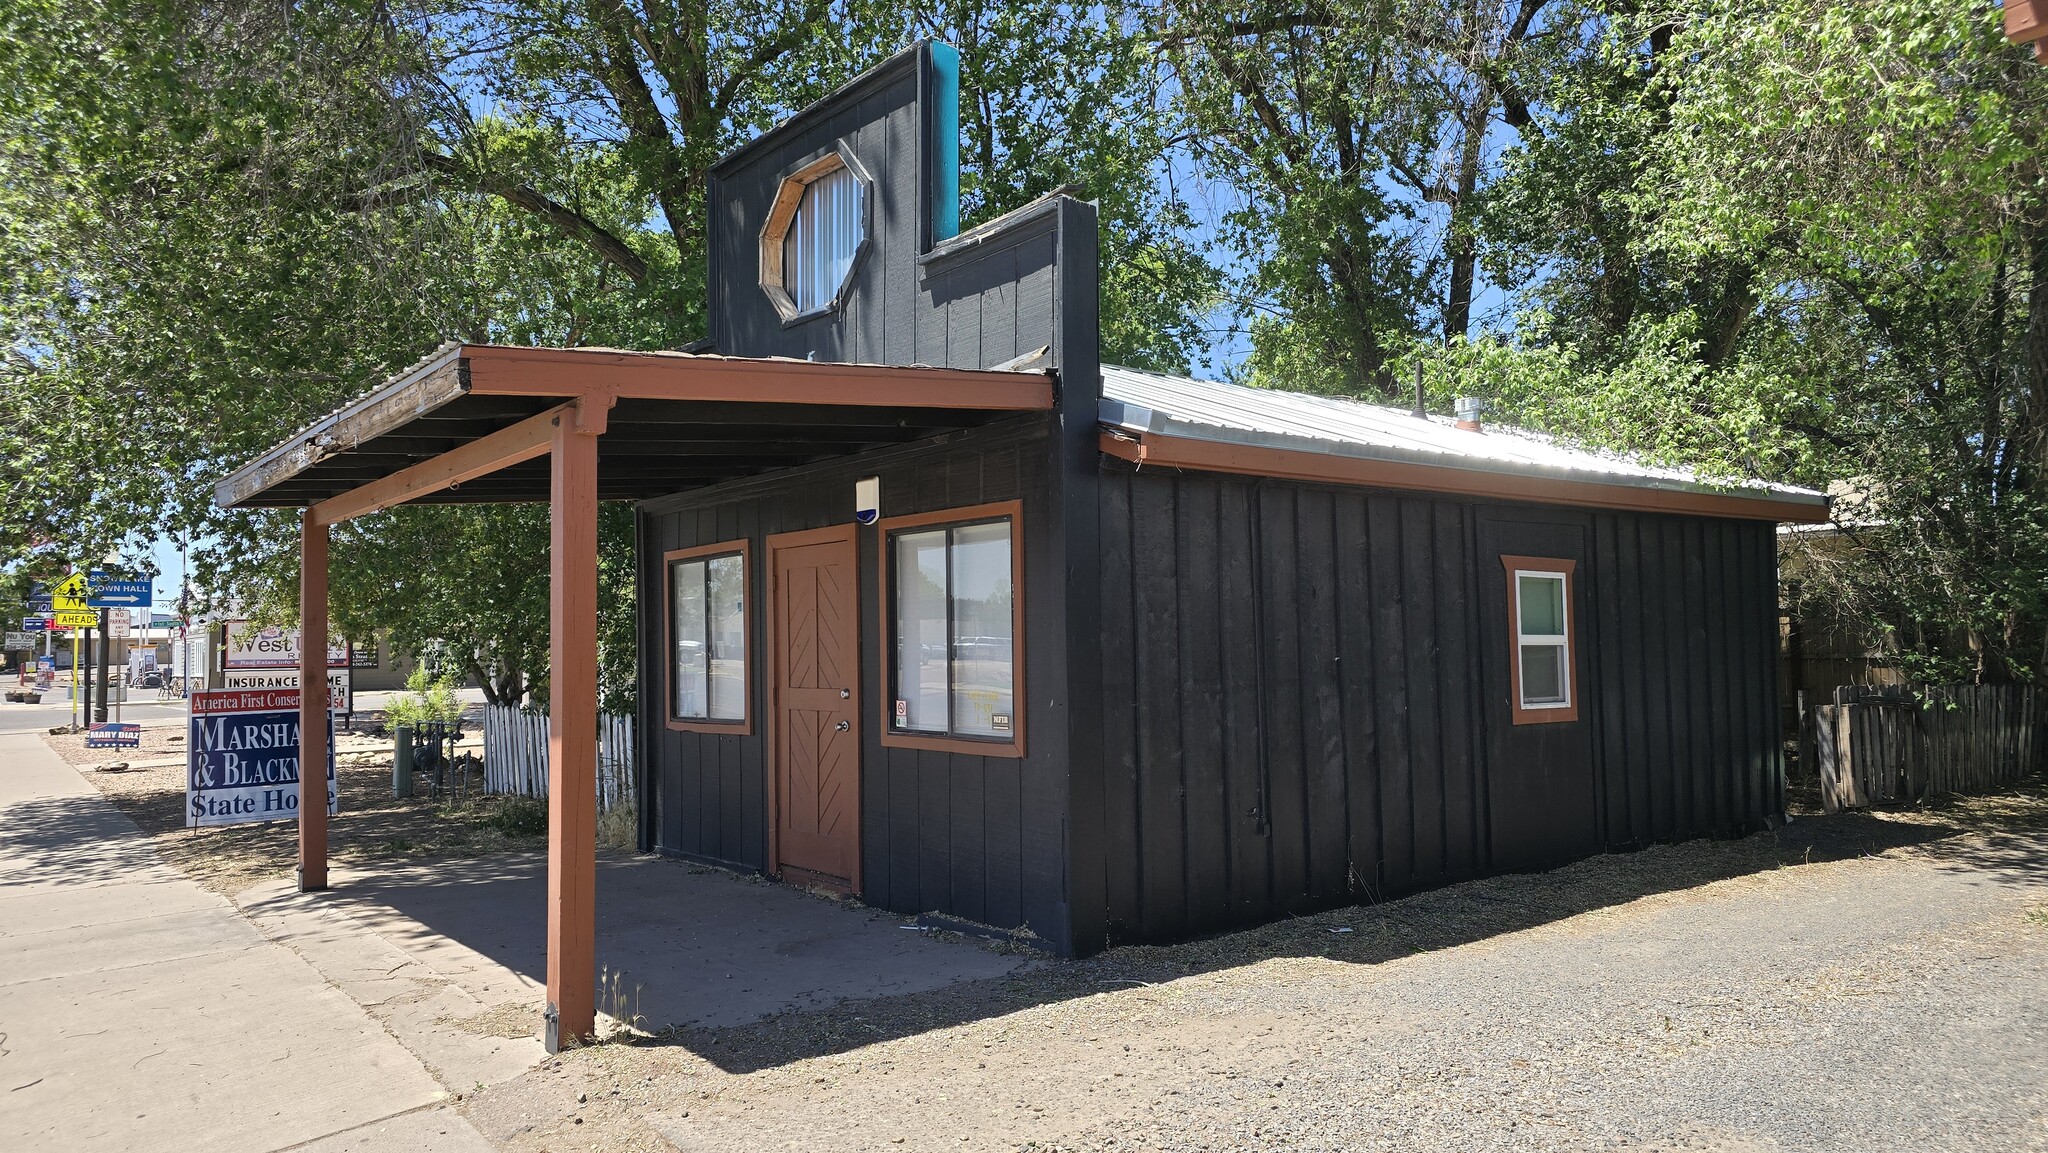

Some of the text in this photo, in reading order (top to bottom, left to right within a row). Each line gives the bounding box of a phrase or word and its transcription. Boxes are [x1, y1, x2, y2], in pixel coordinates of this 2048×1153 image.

[62, 615, 92, 623] AHEAD
[228, 677, 298, 687] INSURANCE
[193, 695, 238, 710] America
[241, 693, 264, 708] First
[118, 731, 139, 739] DIAZ
[194, 753, 215, 787] &
[191, 794, 255, 817] State
